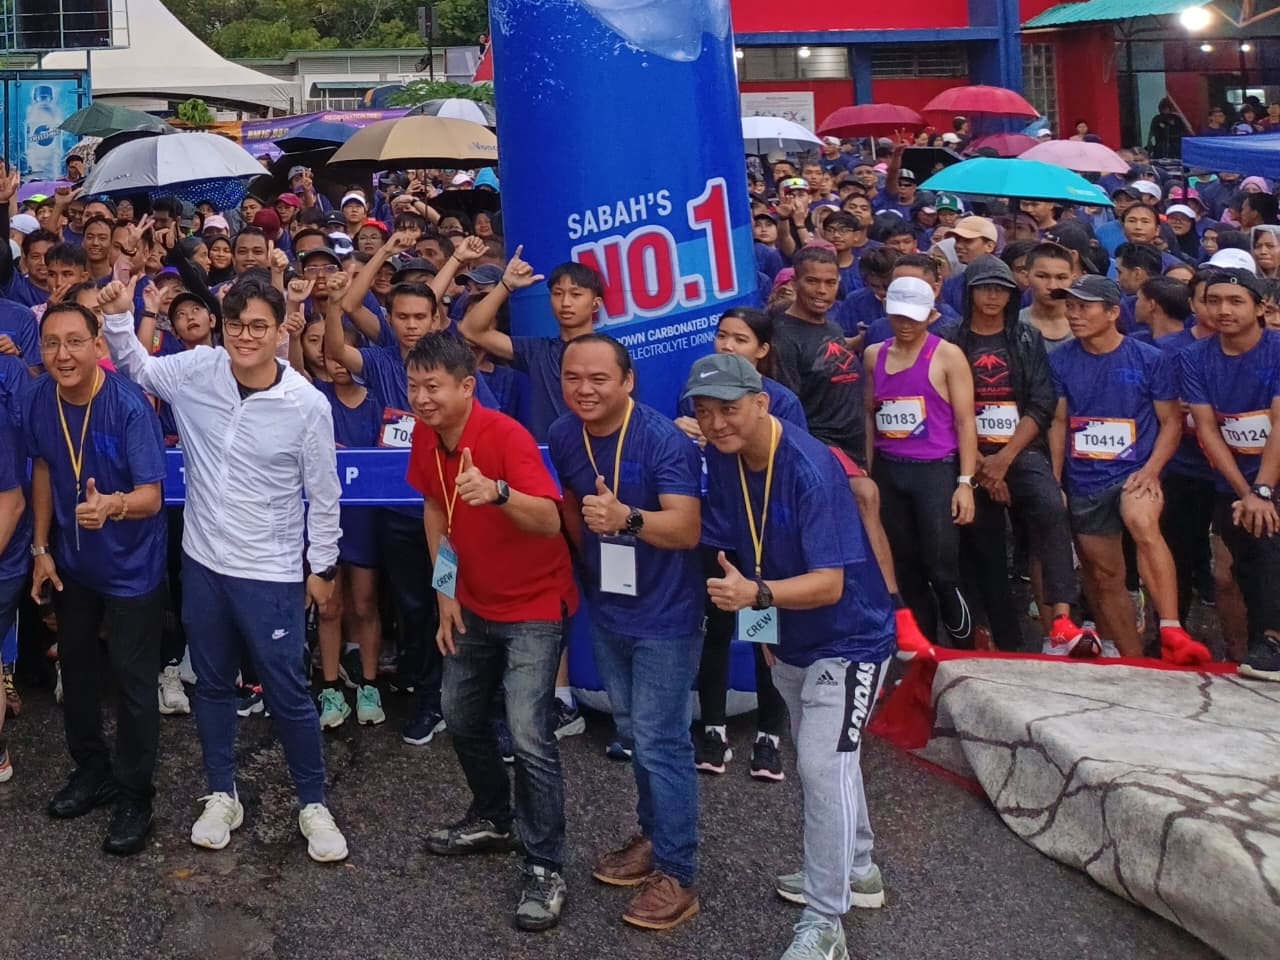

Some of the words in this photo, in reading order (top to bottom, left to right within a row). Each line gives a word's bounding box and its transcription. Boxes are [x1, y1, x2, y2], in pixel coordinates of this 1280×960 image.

[568, 189, 672, 240] SABAH'S
[647, 317, 708, 341] CARBONATED
[880, 413, 917, 426] T0183
[1082, 433, 1126, 448] T0414
[1225, 428, 1268, 442] T0124
[436, 570, 454, 588] CREW
[746, 612, 772, 638] CREW
